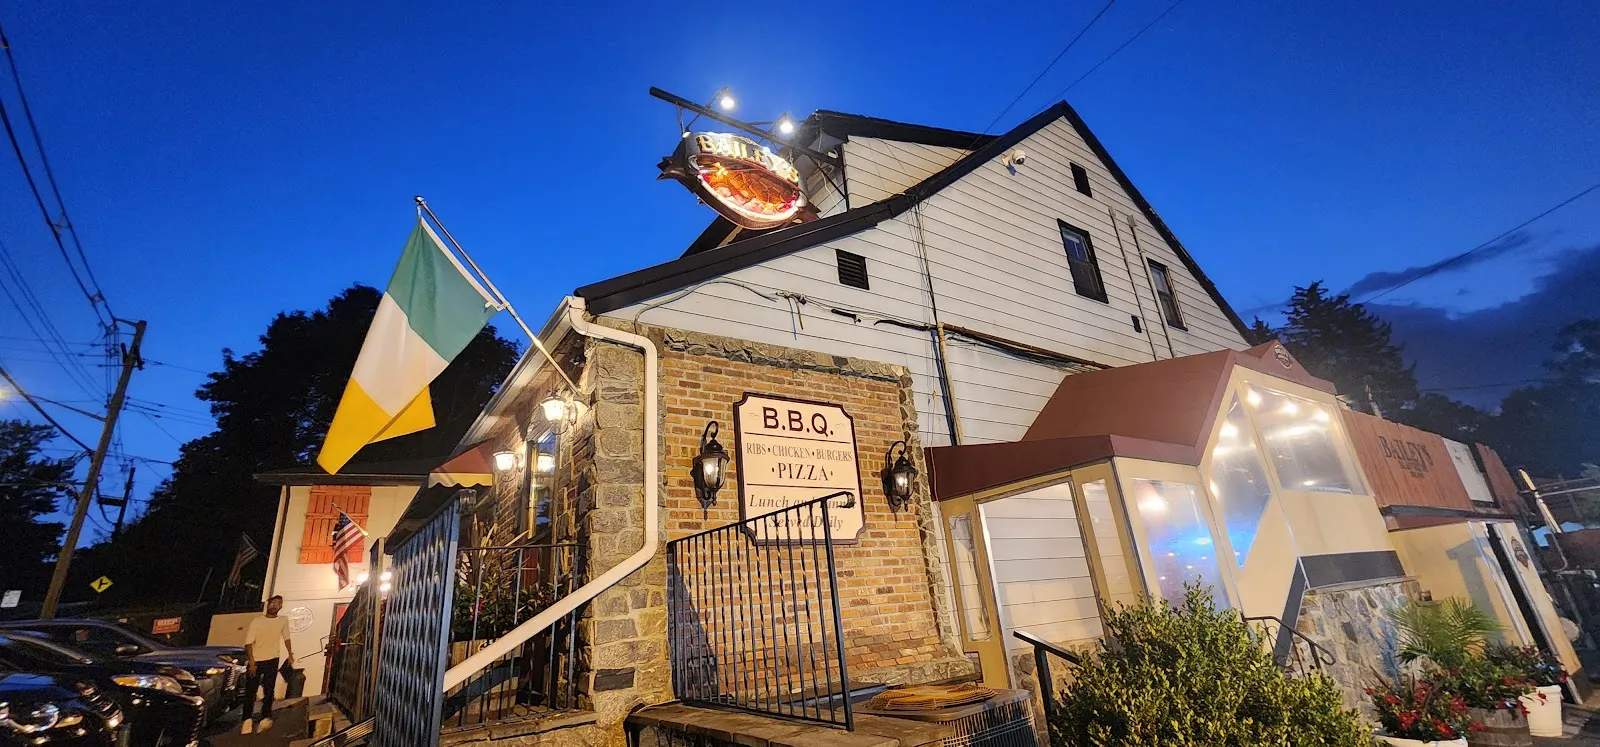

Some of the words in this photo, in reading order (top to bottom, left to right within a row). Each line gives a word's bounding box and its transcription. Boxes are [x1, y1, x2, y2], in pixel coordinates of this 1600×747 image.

[762, 406, 834, 437] B.B.Q.
[746, 442, 767, 456] RIBS
[772, 444, 811, 459] CHICKEN
[816, 449, 853, 462] BURGERS
[777, 462, 830, 482] PIZZA
[749, 493, 789, 508] Lunch
[813, 515, 844, 532] Dily
